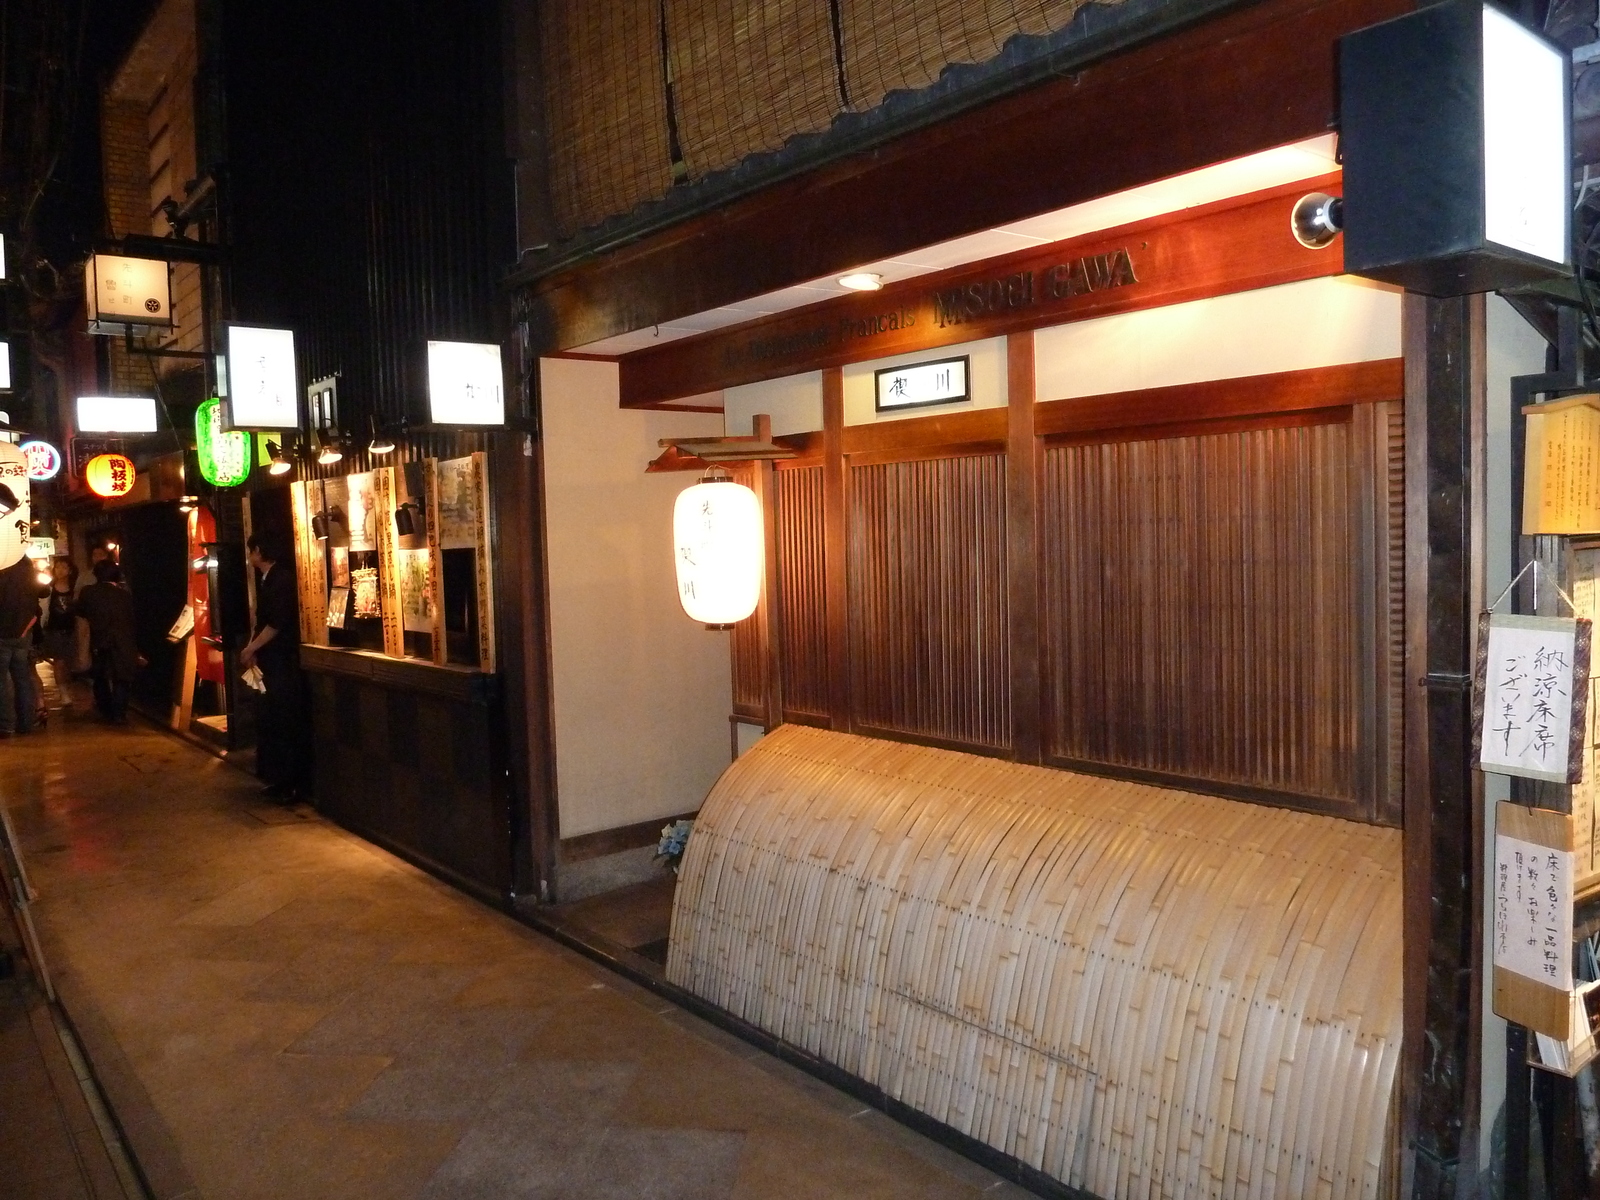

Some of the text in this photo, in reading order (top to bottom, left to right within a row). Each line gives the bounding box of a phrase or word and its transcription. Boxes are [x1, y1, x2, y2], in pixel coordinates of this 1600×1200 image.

[932, 271, 1036, 328] MISOGI
[1049, 247, 1140, 299] GAWA
[108, 458, 127, 492] 陶板焼
[1492, 655, 1528, 757] ございます
